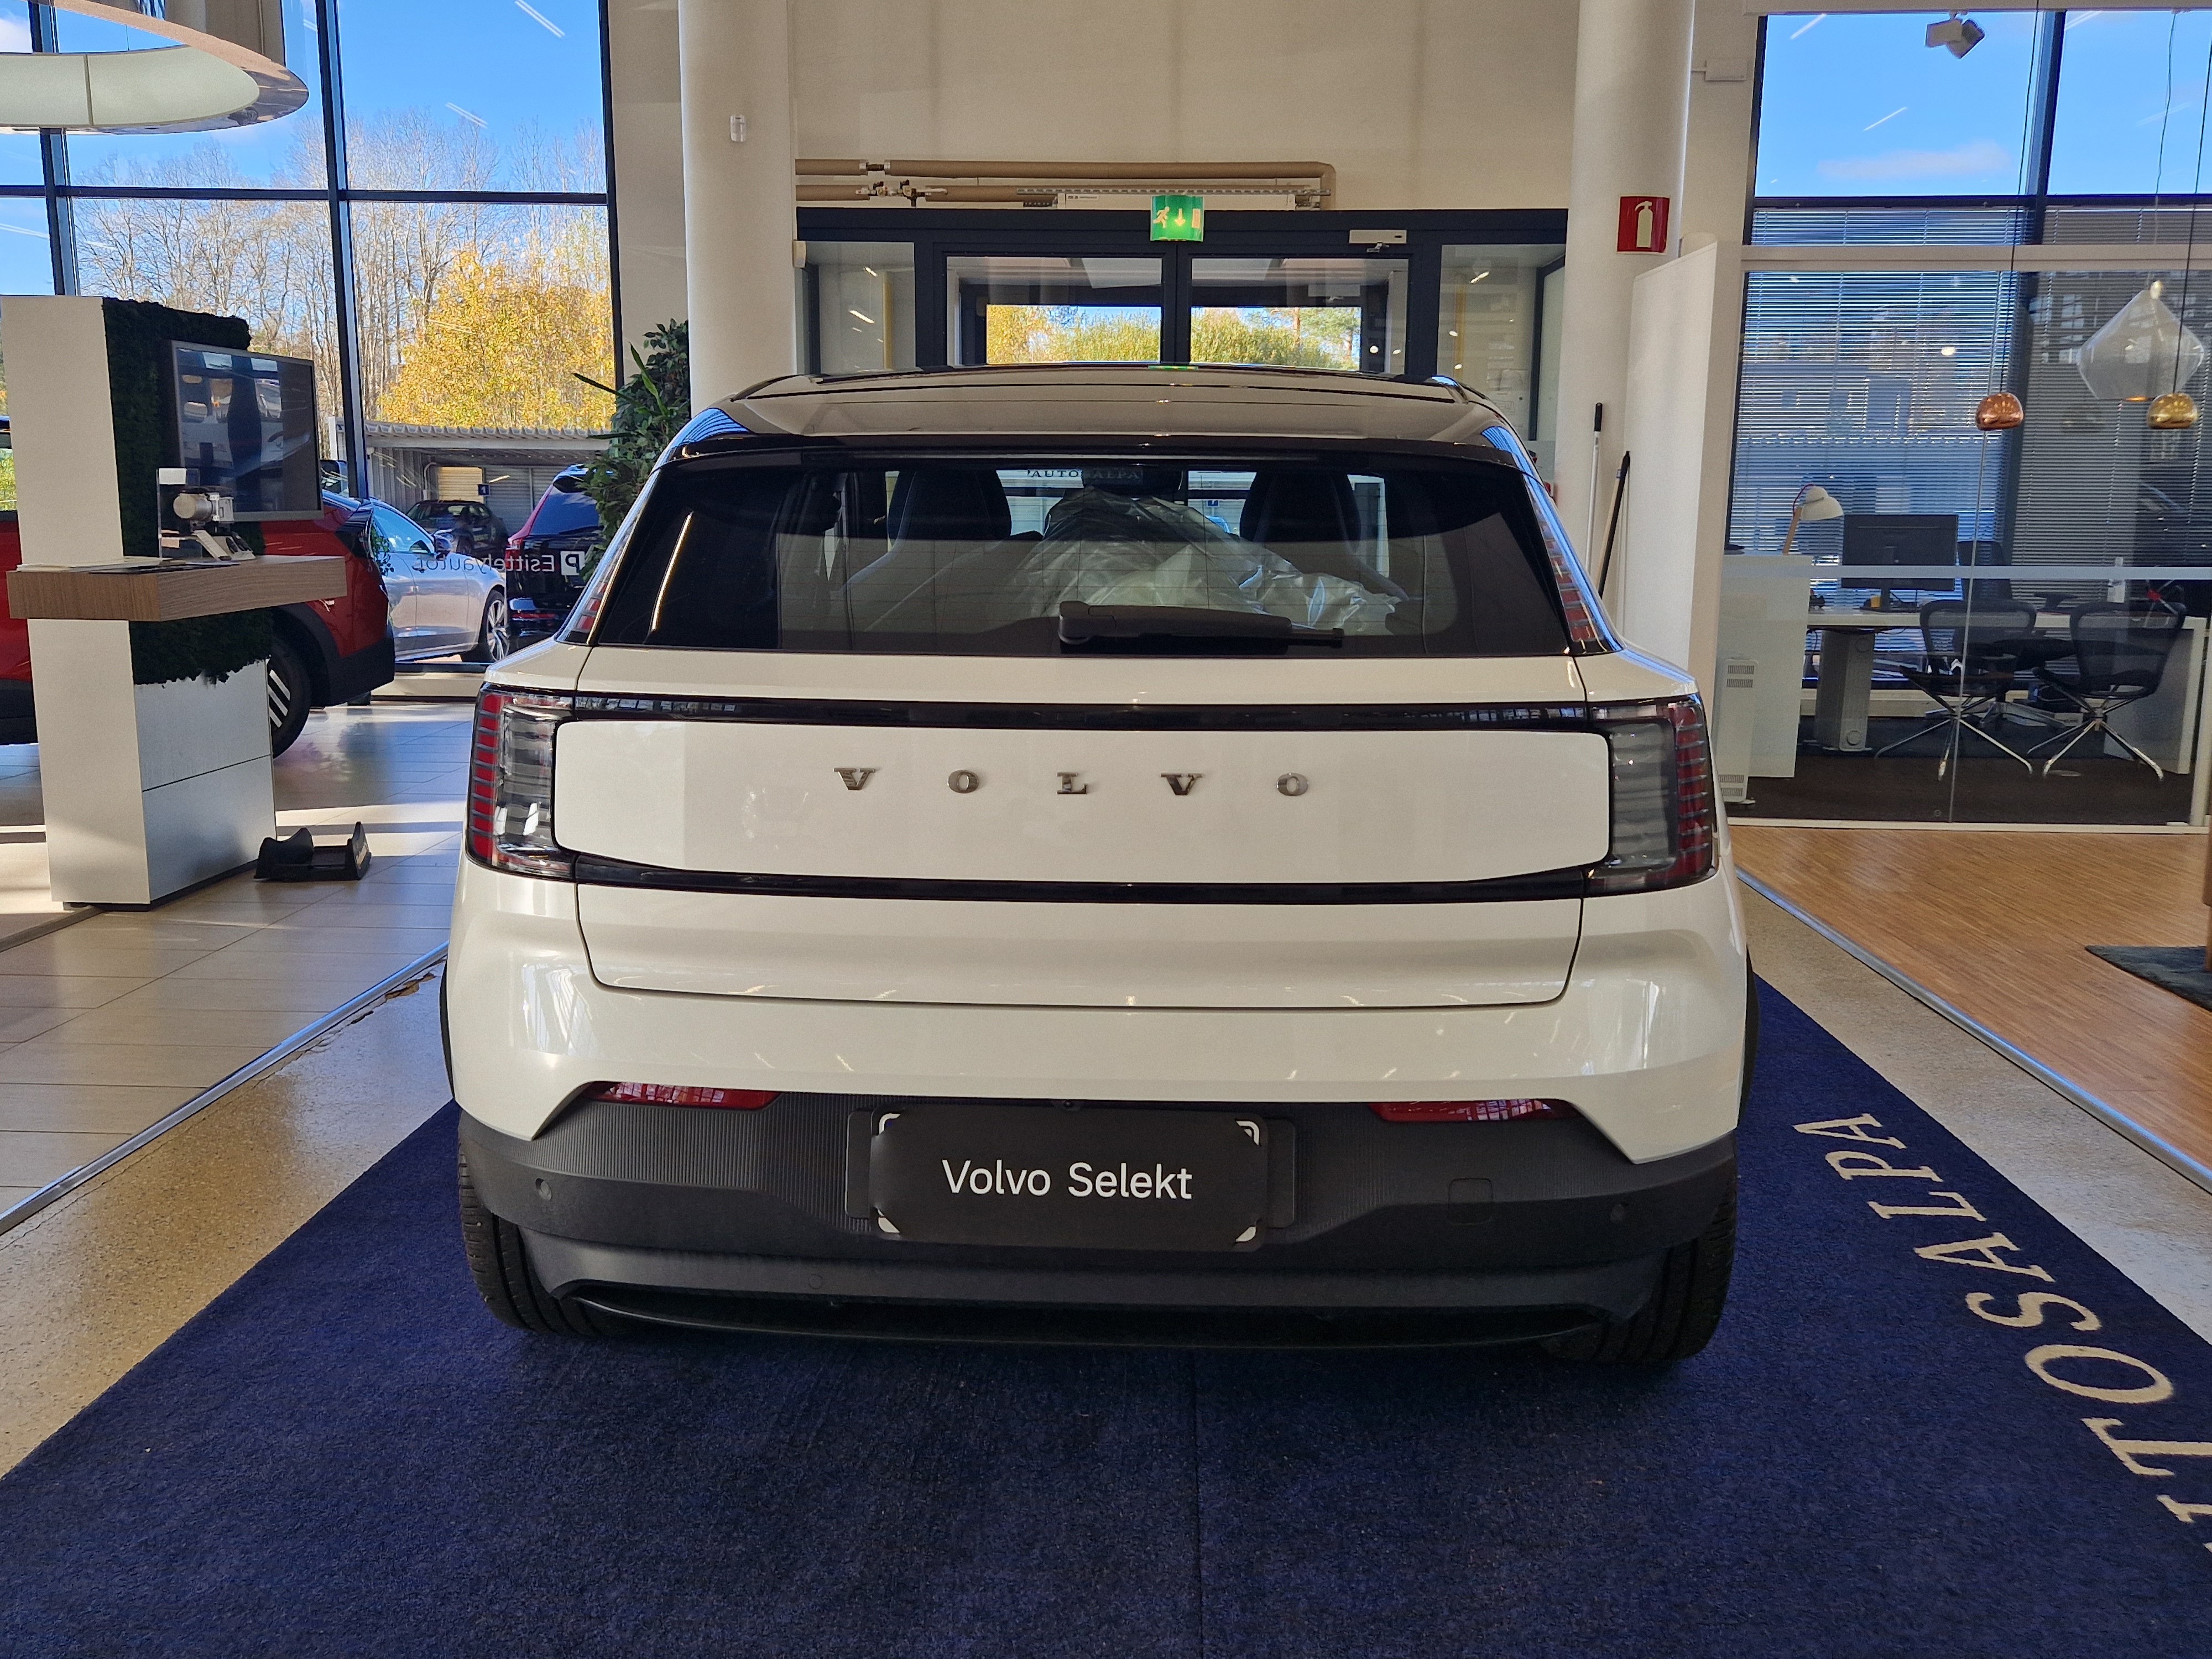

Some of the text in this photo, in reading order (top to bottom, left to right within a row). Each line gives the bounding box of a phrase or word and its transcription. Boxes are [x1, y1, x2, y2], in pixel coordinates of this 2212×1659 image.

[833, 768, 1310, 797] VOLVO
[941, 1159, 1193, 1200] Volvo Selekt
[1793, 1113, 2212, 1555] TOSALPA
